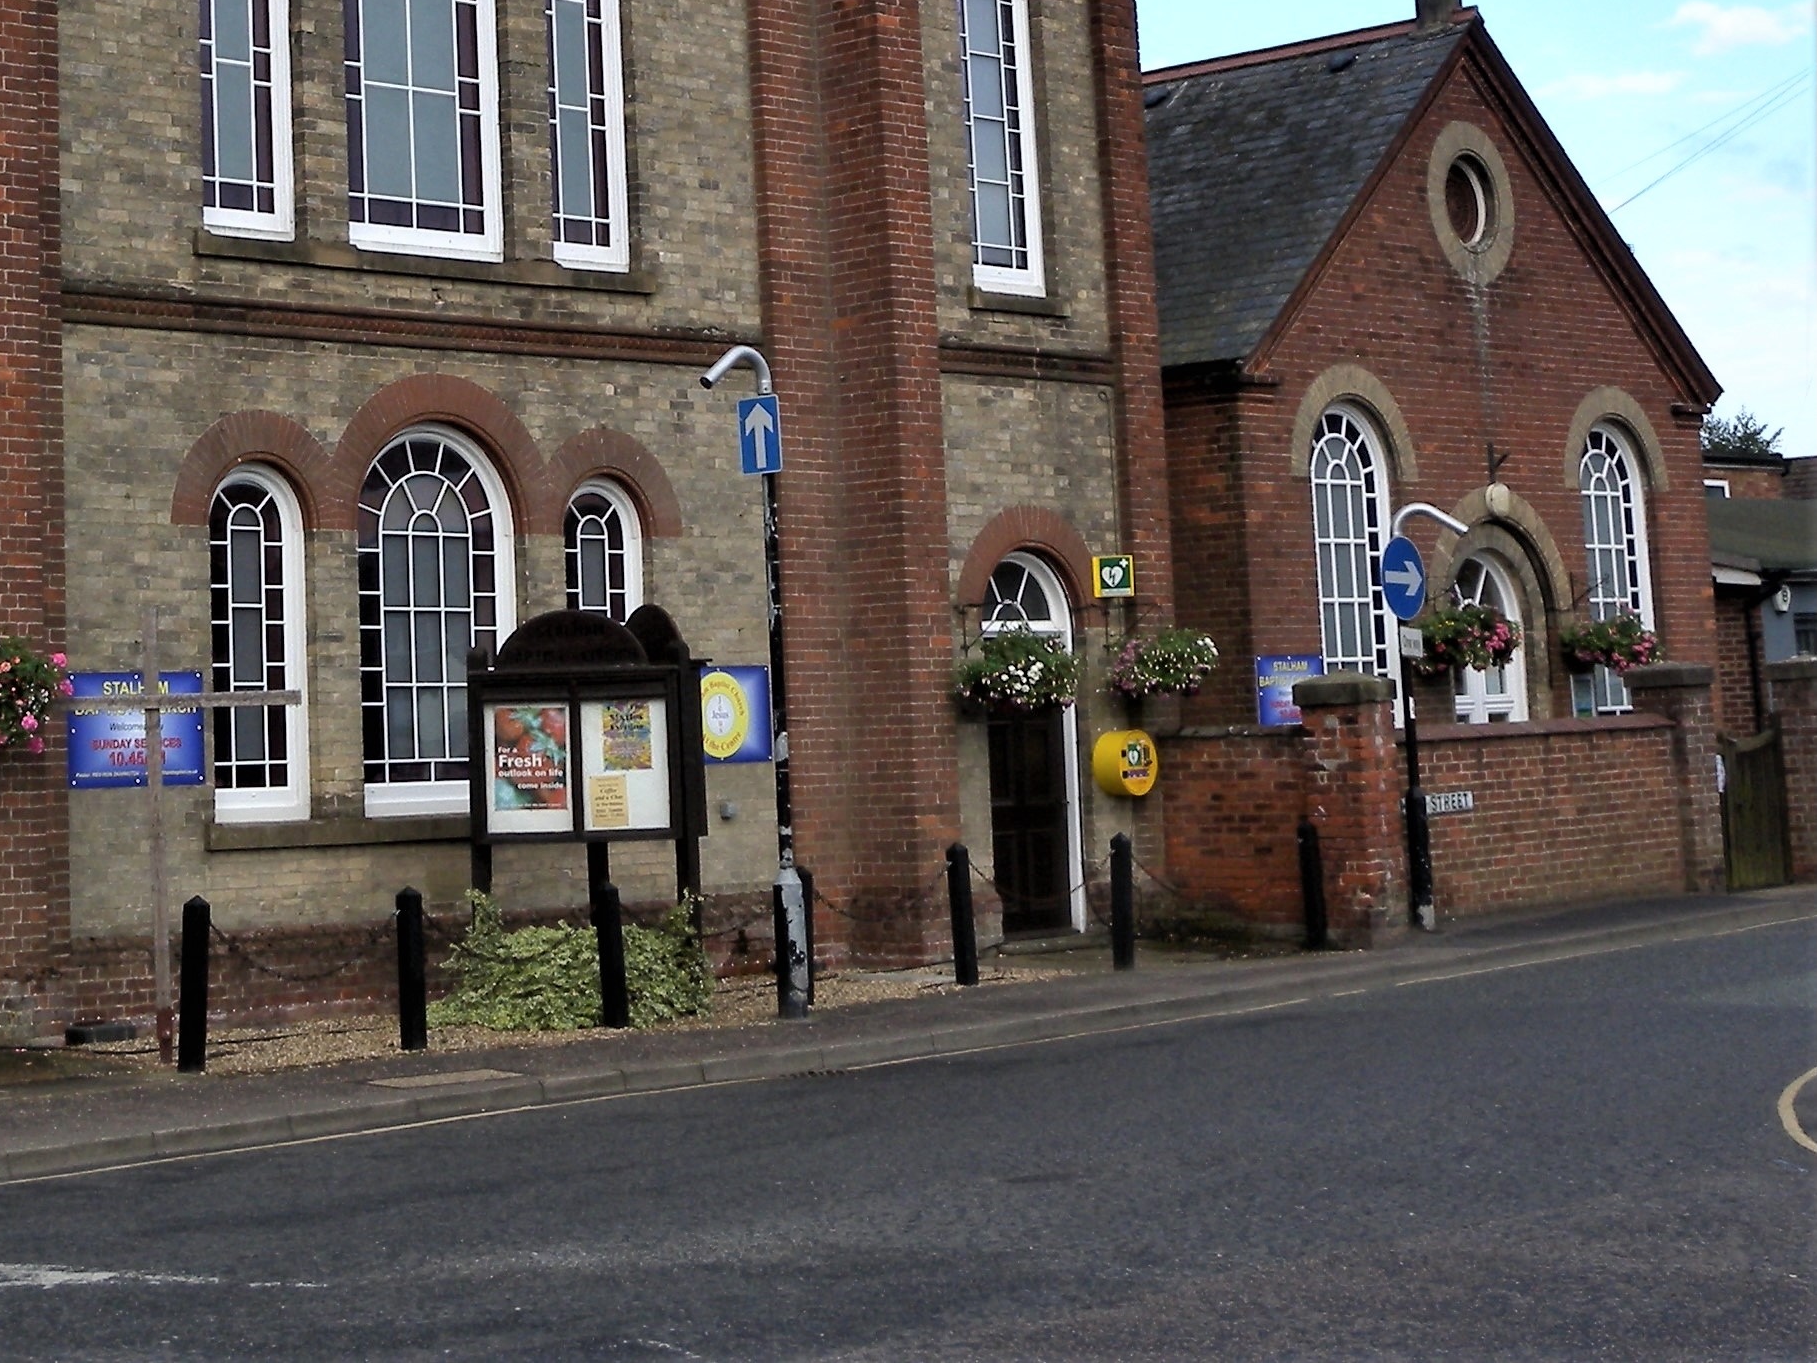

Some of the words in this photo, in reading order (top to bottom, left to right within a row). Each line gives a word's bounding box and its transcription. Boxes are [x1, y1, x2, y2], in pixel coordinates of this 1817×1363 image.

[103, 680, 169, 695] STALHM
[498, 753, 542, 767] Fresh
[498, 769, 533, 777] outlook
[534, 769, 547, 777] on
[548, 768, 564, 777] life
[540, 781, 564, 789] inside
[1430, 792, 1469, 812] STREET
